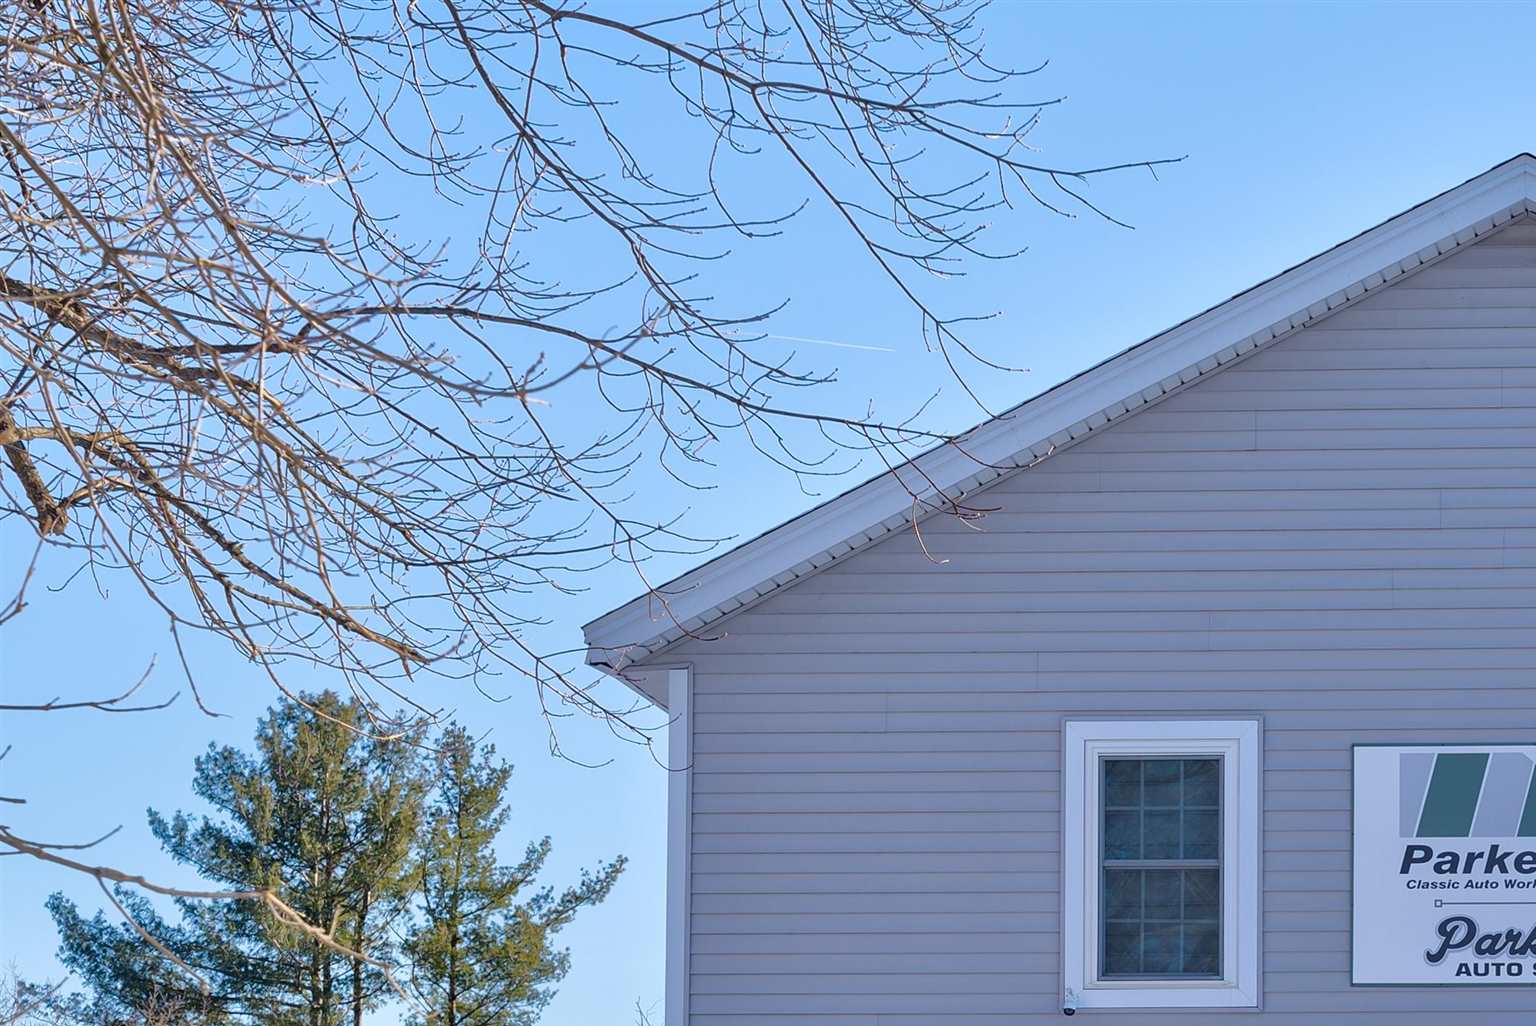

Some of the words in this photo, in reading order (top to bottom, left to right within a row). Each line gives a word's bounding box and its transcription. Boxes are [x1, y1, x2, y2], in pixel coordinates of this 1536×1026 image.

[1406, 879, 1460, 890] Classic
[1464, 879, 1499, 890] Auto
[1455, 962, 1523, 976] AUTO
